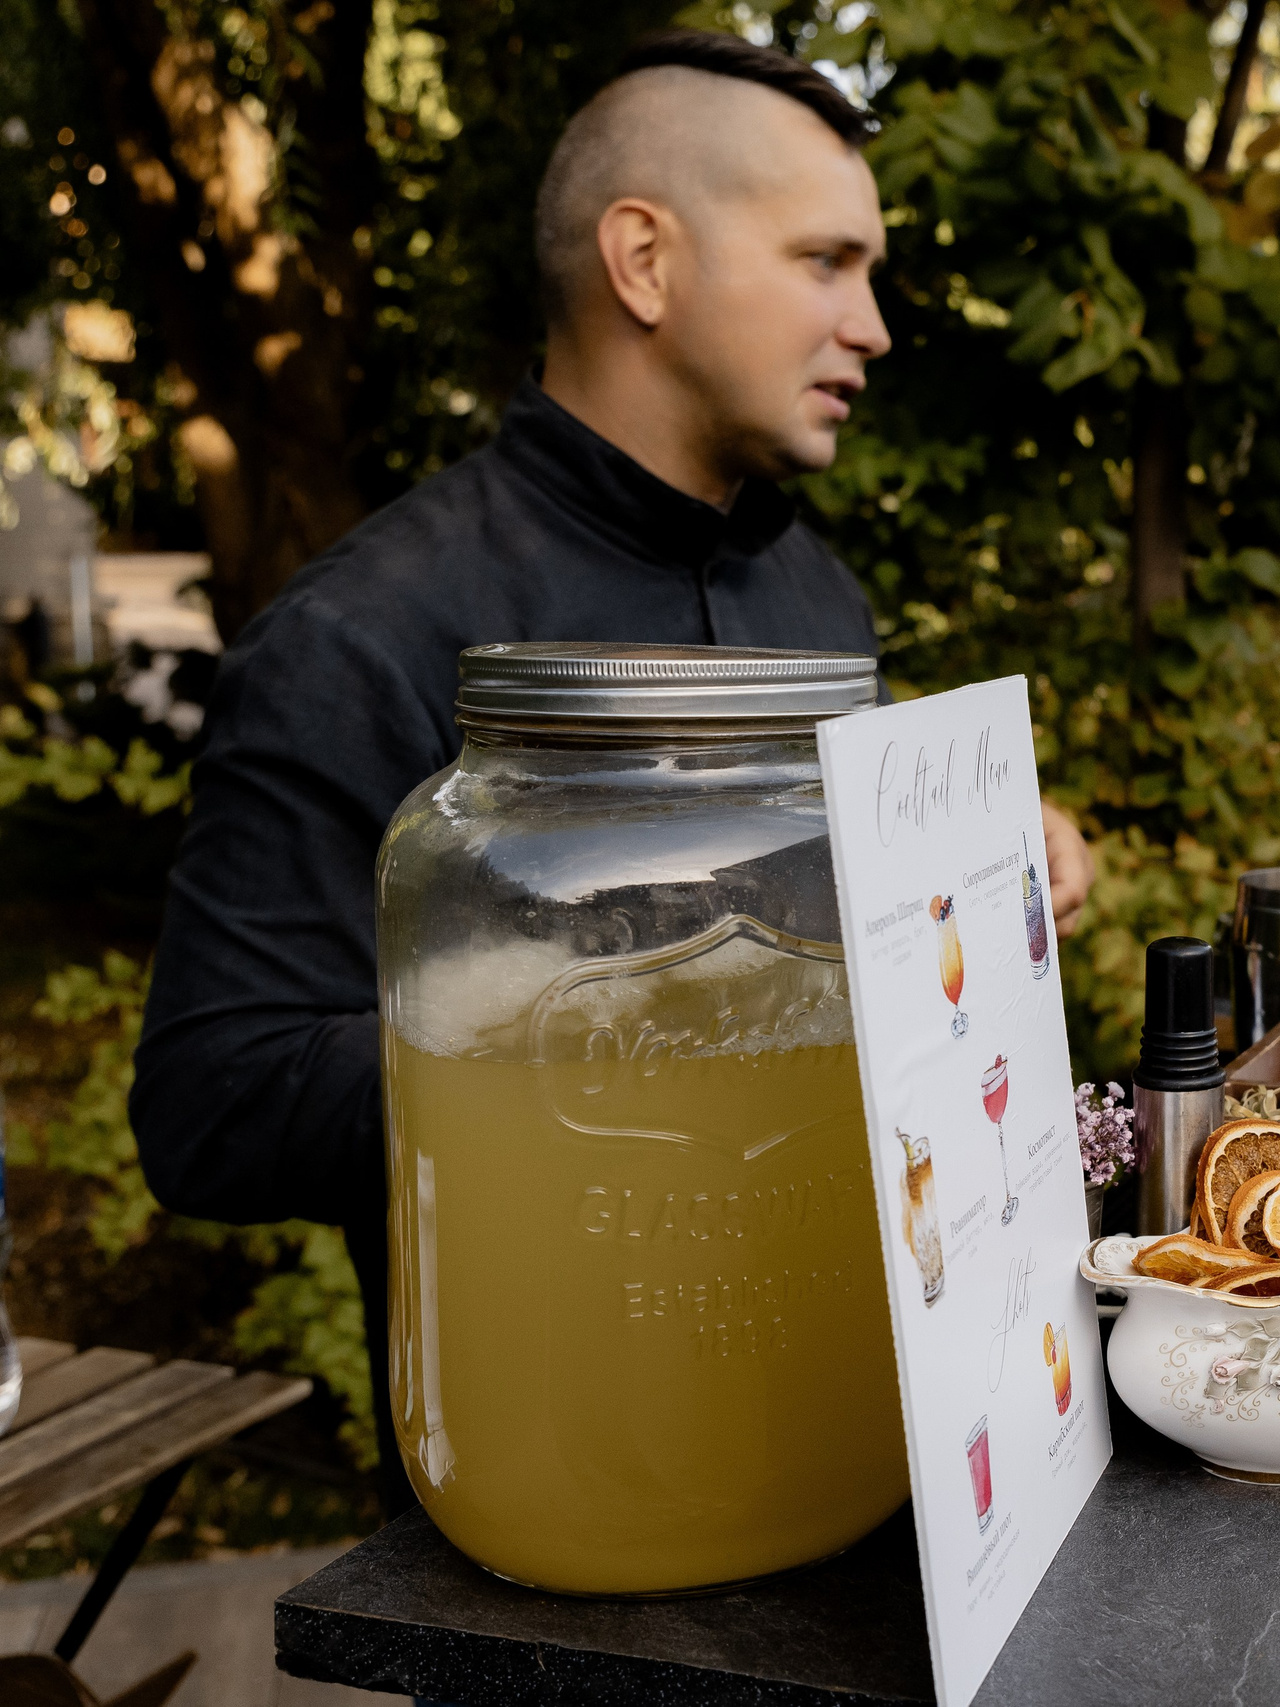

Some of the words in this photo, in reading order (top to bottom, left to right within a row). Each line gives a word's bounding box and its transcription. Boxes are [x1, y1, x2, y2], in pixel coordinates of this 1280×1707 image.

[875, 739, 956, 847] Cocktail
[967, 725, 1012, 813] Menu
[962, 856, 1005, 889] Смородиновый
[1005, 852, 1020, 871] сауэр
[1027, 1124, 1057, 1160] Космотвист
[949, 1194, 987, 1239] Реаниматор
[987, 1247, 1037, 1393] Shots
[1047, 1413, 1075, 1461] Карибский
[1074, 1399, 1084, 1421] шот
[966, 1528, 1000, 1588] Вишнёвый
[1000, 1511, 1012, 1537] шот
